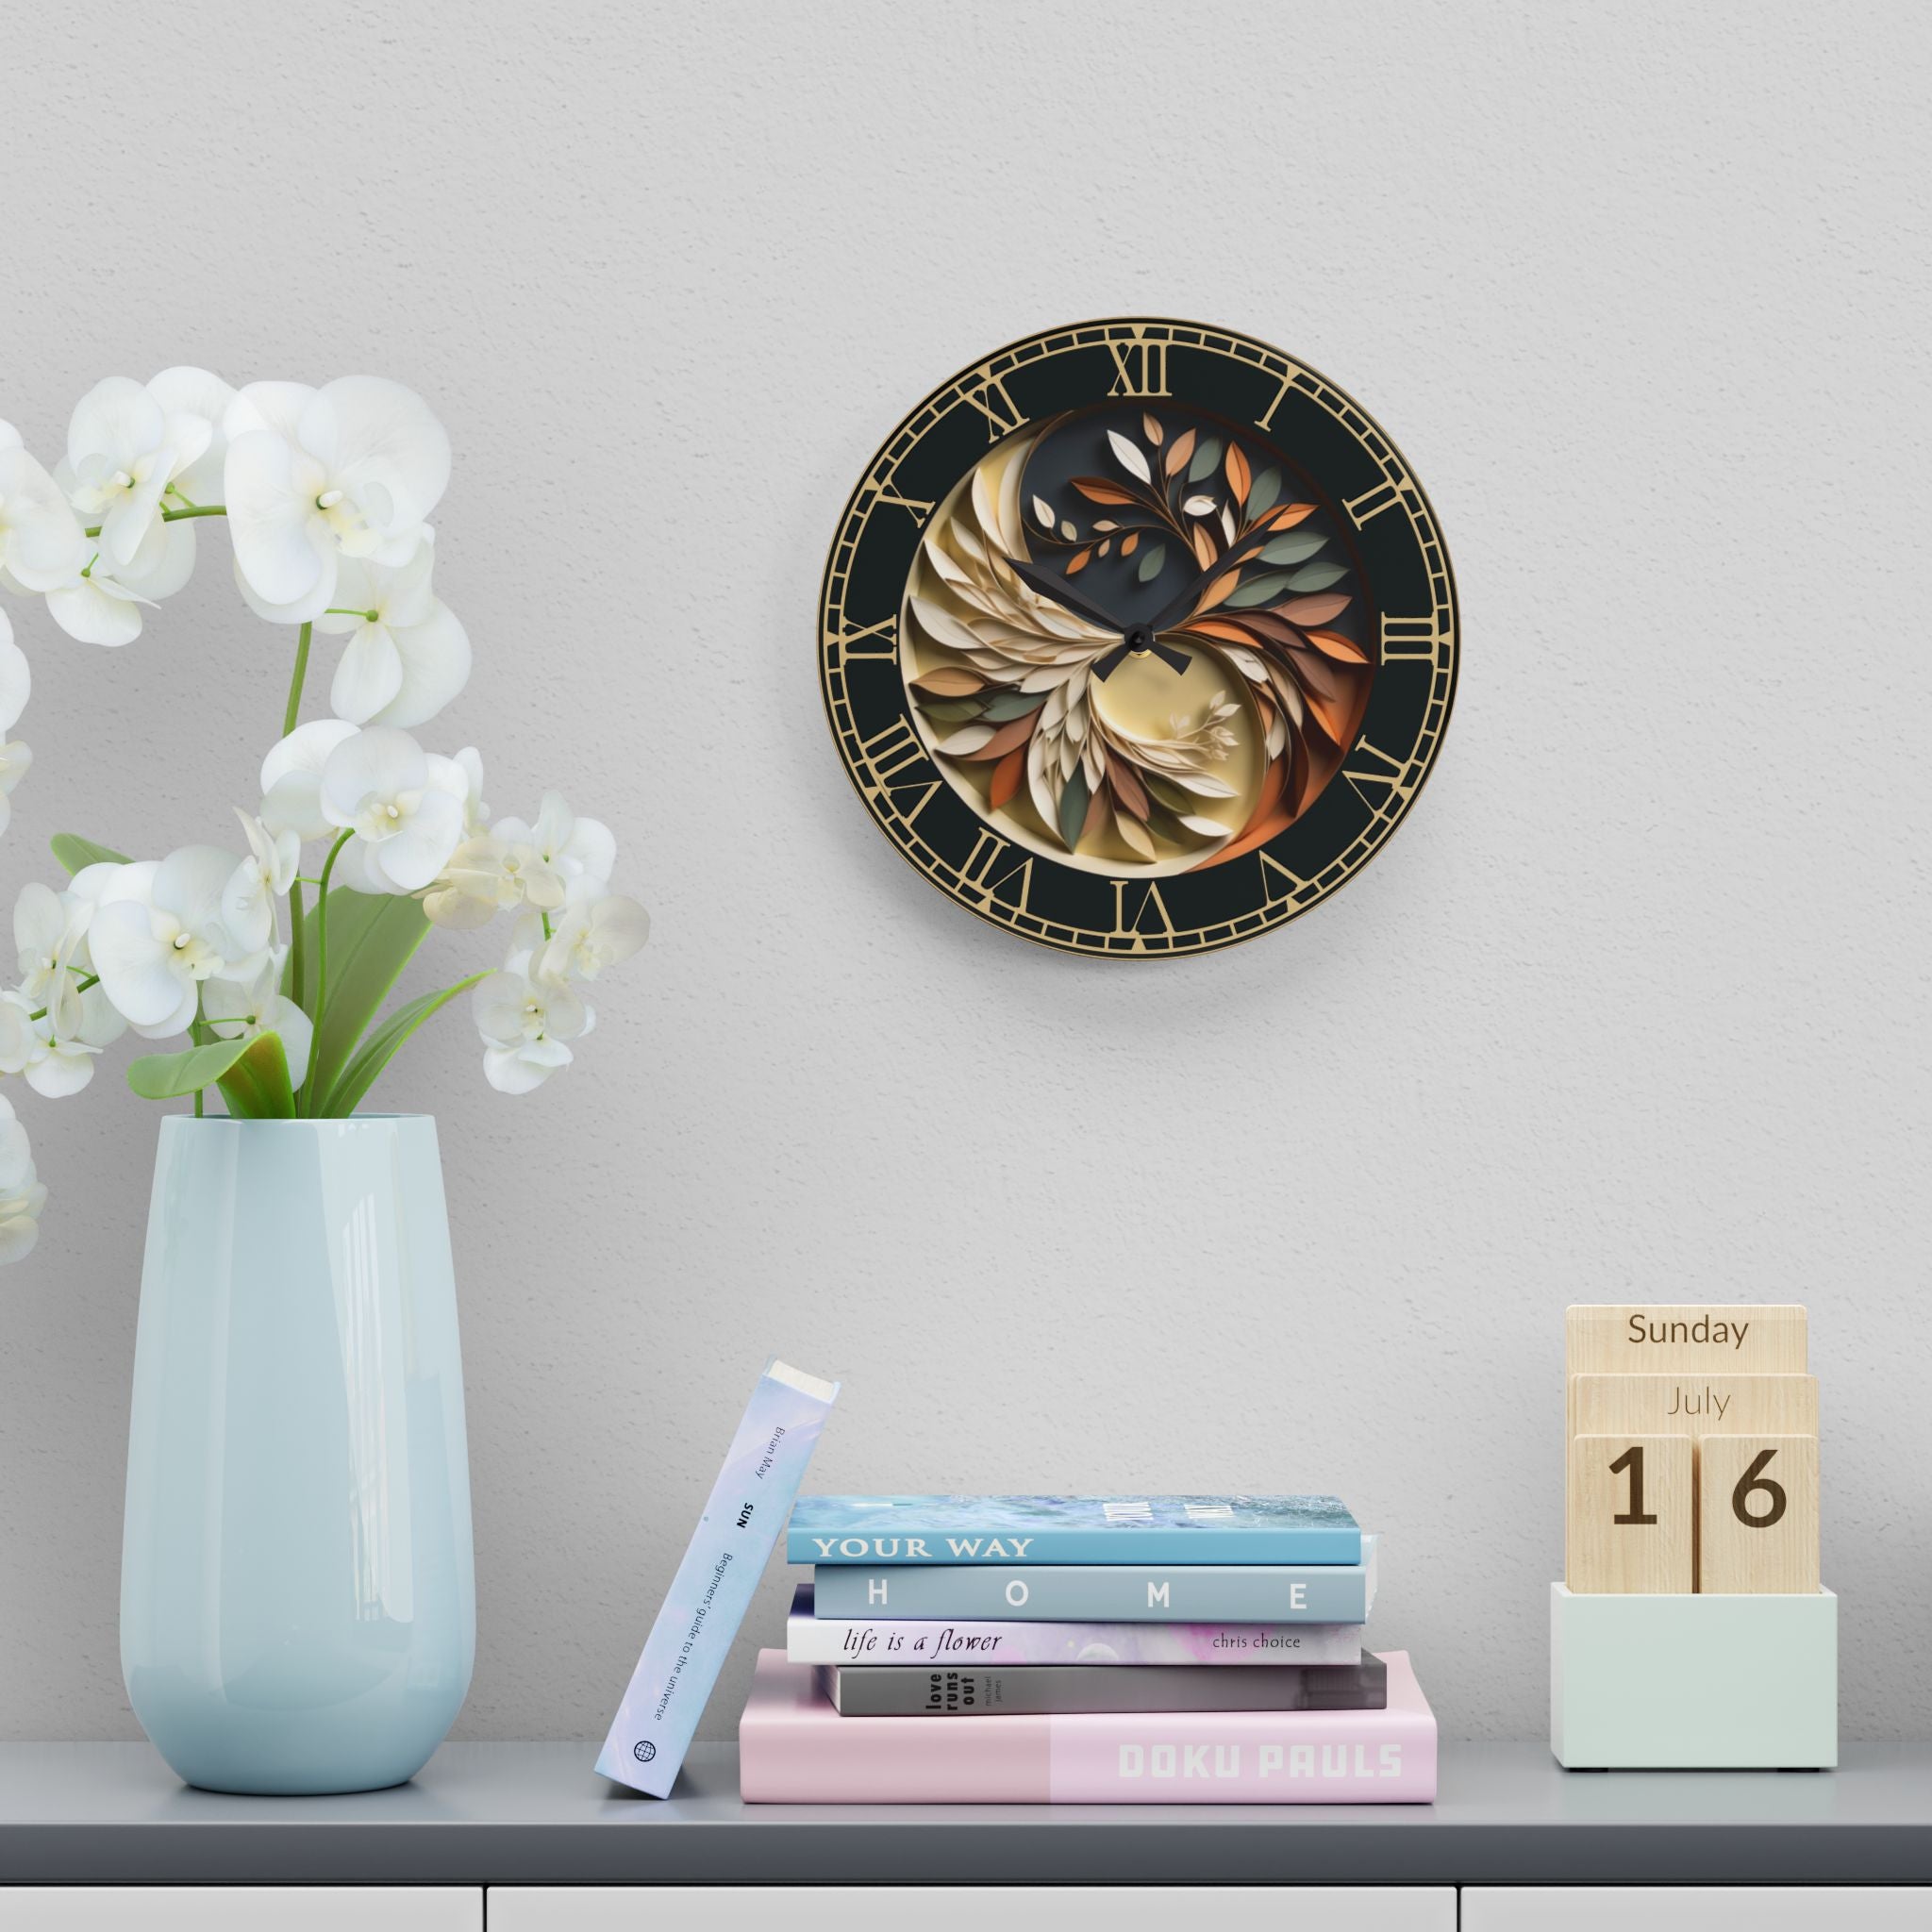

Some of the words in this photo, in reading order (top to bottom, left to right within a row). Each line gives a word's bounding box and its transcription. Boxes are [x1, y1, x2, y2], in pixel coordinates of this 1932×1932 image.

[1107, 341, 1173, 397] XII
[959, 375, 1030, 443] XI
[874, 473, 936, 528] X
[1341, 477, 1404, 531] II
[842, 614, 897, 665] IX
[1381, 611, 1438, 666] III
[859, 713, 943, 826] VIII
[1341, 735, 1408, 818] IV
[958, 827, 1034, 912] VII
[1258, 850, 1309, 907] V
[1109, 880, 1177, 937] VI
[1628, 1314, 1749, 1350] Sunday
[1667, 1386, 1731, 1421] July
[766, 1426, 785, 1454] Brian
[755, 1457, 773, 1479] May
[737, 1503, 754, 1528] SUN
[812, 1539, 933, 1557] YOUR
[945, 1539, 1035, 1557] WAY
[703, 1553, 733, 1608] Beginners'
[689, 1608, 707, 1640] guide
[1212, 1633, 1247, 1648] chris
[1253, 1633, 1301, 1648] choice
[682, 1642, 693, 1653] to
[843, 1629, 876, 1659] life
[887, 1633, 904, 1651] is
[913, 1636, 927, 1651] a
[930, 1629, 1003, 1659] flower
[674, 1656, 690, 1674] the
[655, 1676, 678, 1721] universe
[925, 1674, 941, 1709] love
[946, 1673, 958, 1711] runs
[961, 1677, 974, 1706] out
[1118, 1744, 1241, 1778] DOKU
[1258, 1744, 1403, 1778] PAULS
